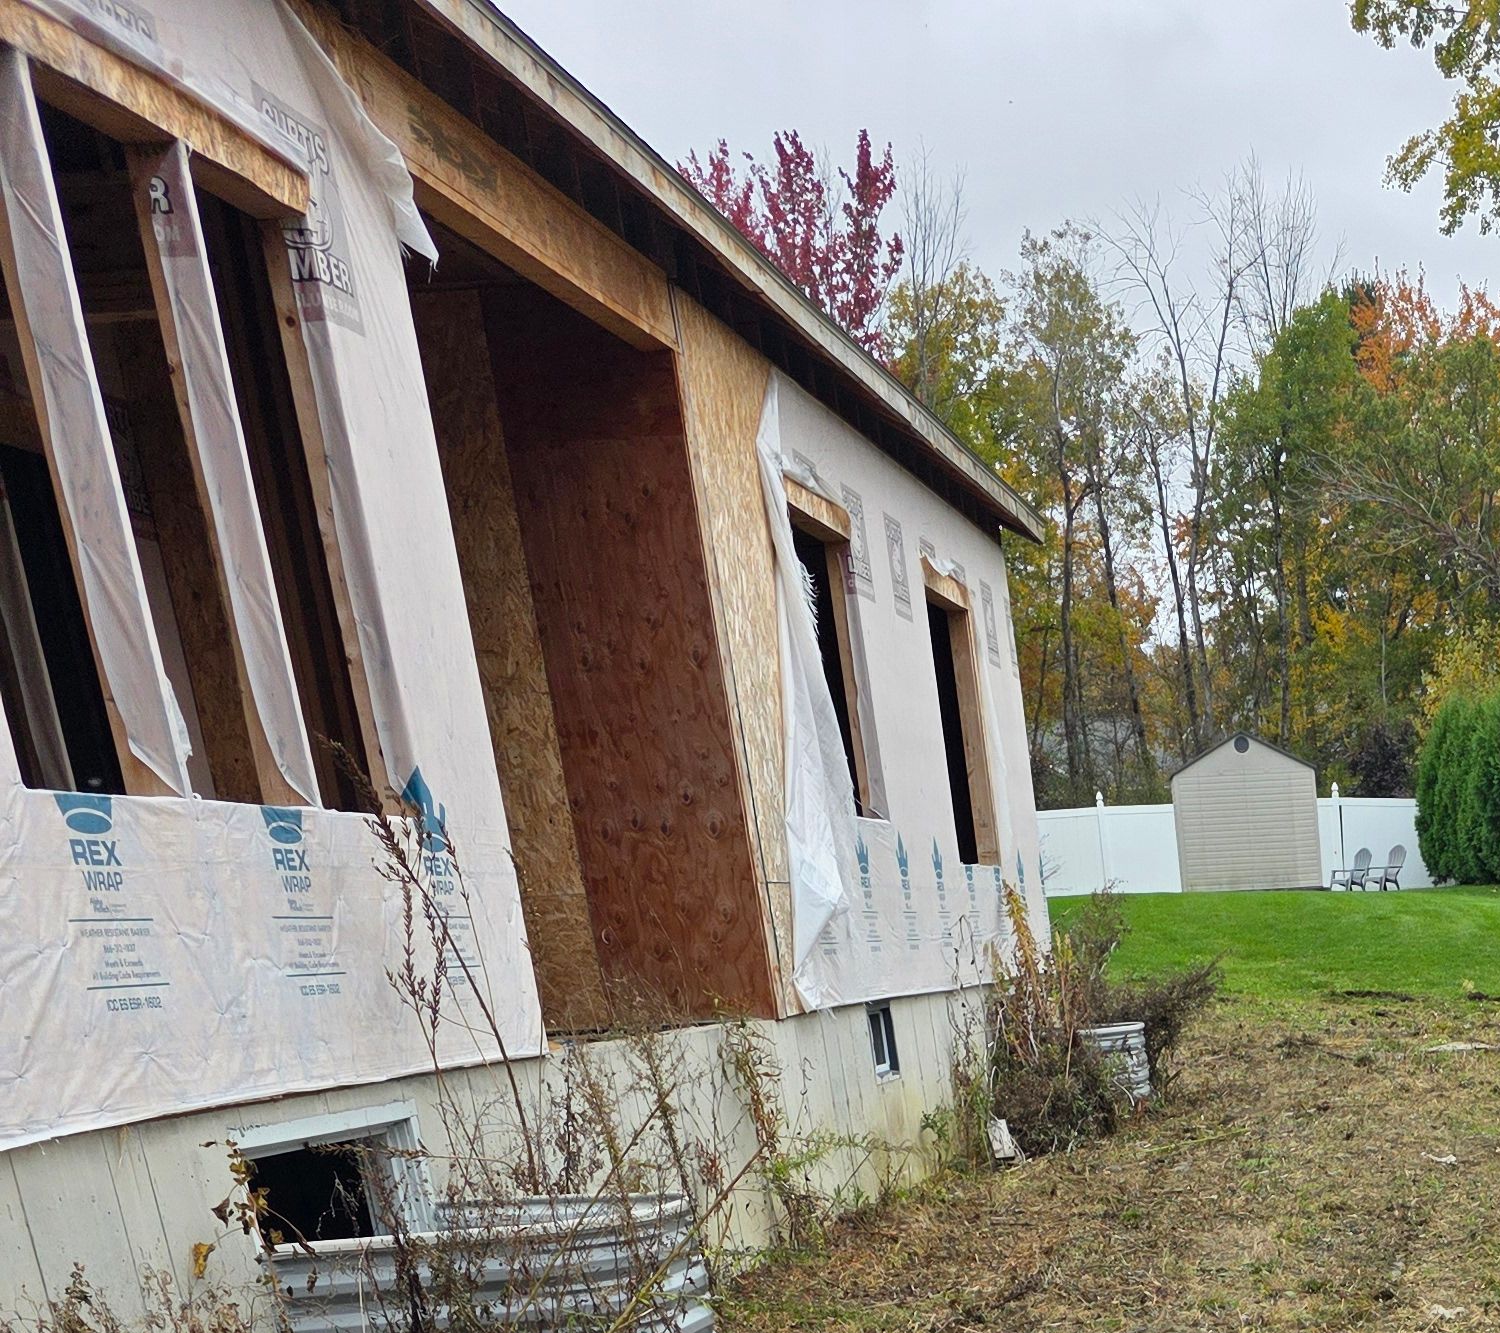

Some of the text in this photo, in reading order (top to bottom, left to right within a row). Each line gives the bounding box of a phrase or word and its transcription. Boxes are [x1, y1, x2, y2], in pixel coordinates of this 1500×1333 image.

[68, 838, 123, 867] REX
[272, 847, 311, 872] REX
[423, 856, 453, 877] REX
[81, 870, 124, 892] WRAP
[281, 875, 312, 893] WRAP
